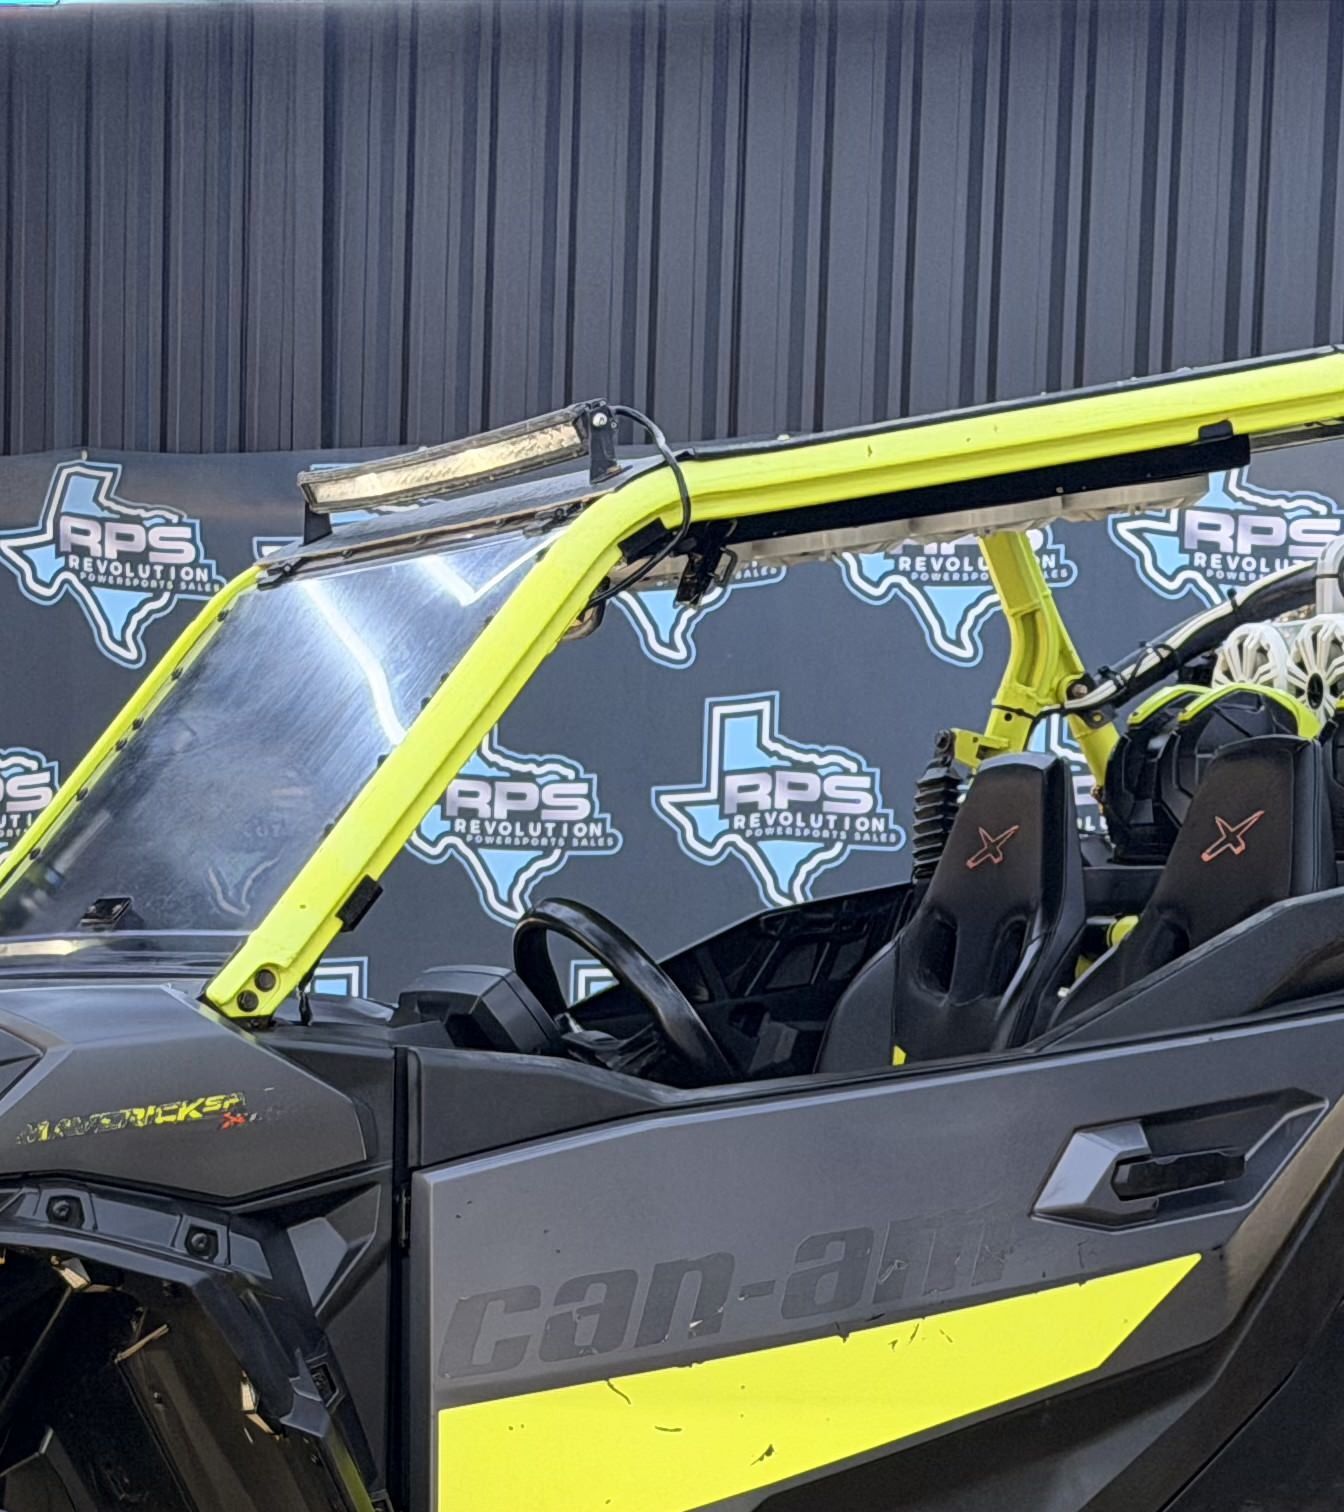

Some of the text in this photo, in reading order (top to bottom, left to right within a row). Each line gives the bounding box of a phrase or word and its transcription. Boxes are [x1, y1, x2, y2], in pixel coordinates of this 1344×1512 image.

[60, 516, 196, 564] RPS
[1183, 510, 1341, 558] RPS
[68, 554, 209, 582] REVOLUTION
[80, 571, 174, 590] POWERSPORTS
[446, 781, 591, 820] RPS
[724, 772, 875, 815] RPS
[453, 818, 603, 838] REVOLUTION
[733, 811, 885, 832] REVOLUTION
[466, 834, 614, 847] POWERSPORTS SALES
[745, 827, 897, 843] POWERSPORTS SALES
